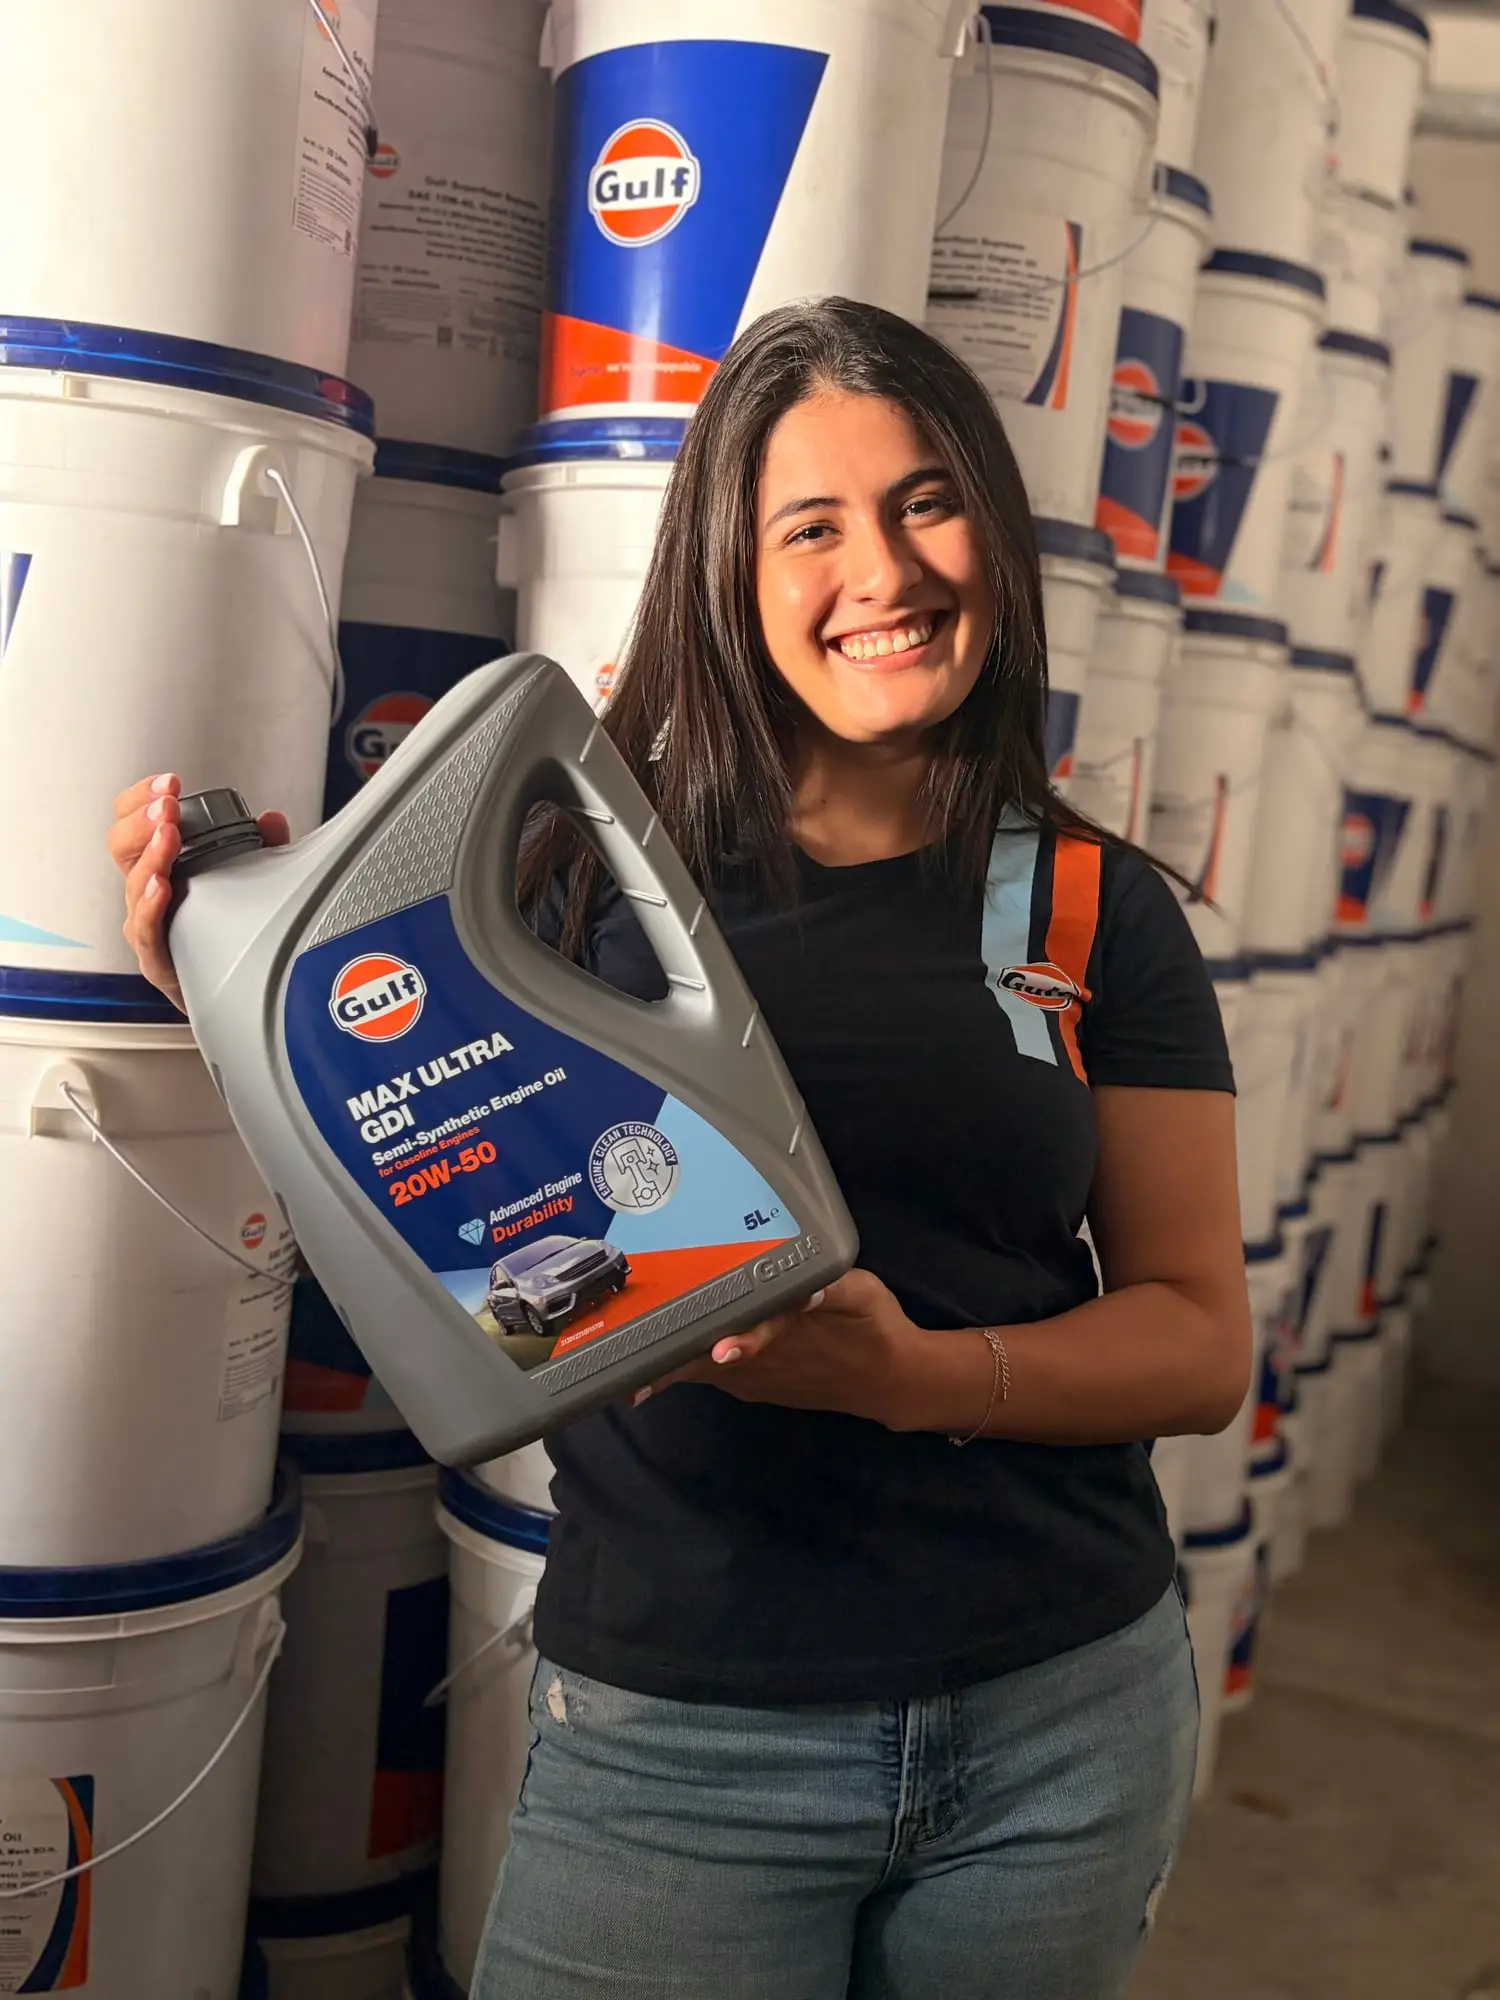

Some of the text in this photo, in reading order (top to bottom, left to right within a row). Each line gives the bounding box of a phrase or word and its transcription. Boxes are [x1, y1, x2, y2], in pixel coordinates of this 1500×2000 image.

[595, 166, 690, 205] Gulf
[337, 973, 417, 1022] Gulf
[346, 1032, 515, 1121] MAX ULTRA
[360, 1104, 416, 1144] GDI
[372, 1067, 567, 1166] Semi-Synthetic Engine Oil
[378, 1126, 480, 1178] for Gasoline Engines
[388, 1141, 497, 1208] 20W-50
[592, 1125, 677, 1197] ENGINE CLEAN TECHNOLOGY
[489, 1172, 583, 1225] Advanced Engine
[491, 1195, 574, 1244] Durability
[743, 1209, 771, 1231] 5L
[753, 1234, 822, 1282] Gulf
